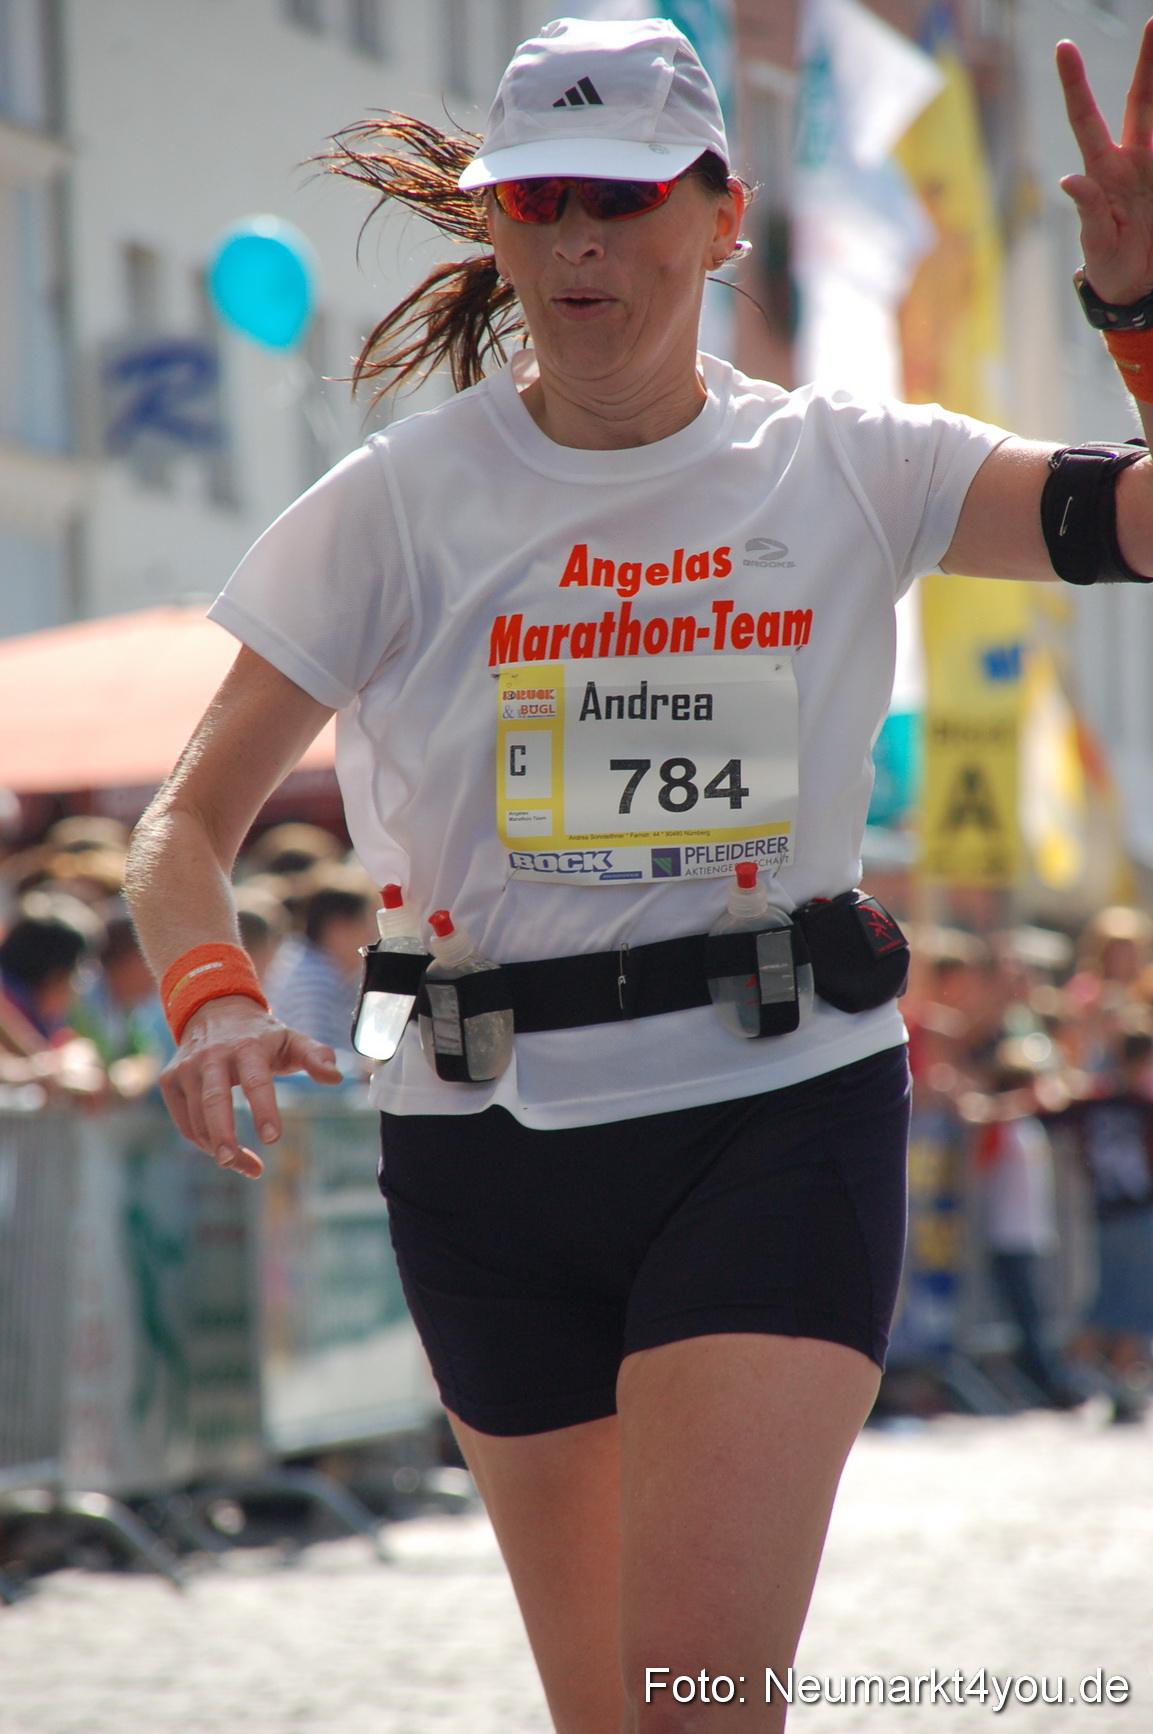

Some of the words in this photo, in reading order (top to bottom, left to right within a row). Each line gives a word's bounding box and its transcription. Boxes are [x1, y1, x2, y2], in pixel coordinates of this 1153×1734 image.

[558, 544, 732, 598] Angelas
[743, 559, 797, 568] BROOKS
[488, 600, 814, 668] Marathon-Team
[502, 704, 516, 719] &
[520, 704, 556, 715] BÜGL
[579, 680, 713, 721] Andrea
[510, 745, 526, 776] C
[610, 757, 749, 814] 784
[509, 850, 613, 873] BOCK
[685, 836, 789, 864] PFLEIDERER
[685, 855, 790, 877] AKTIENGESCHAFT
